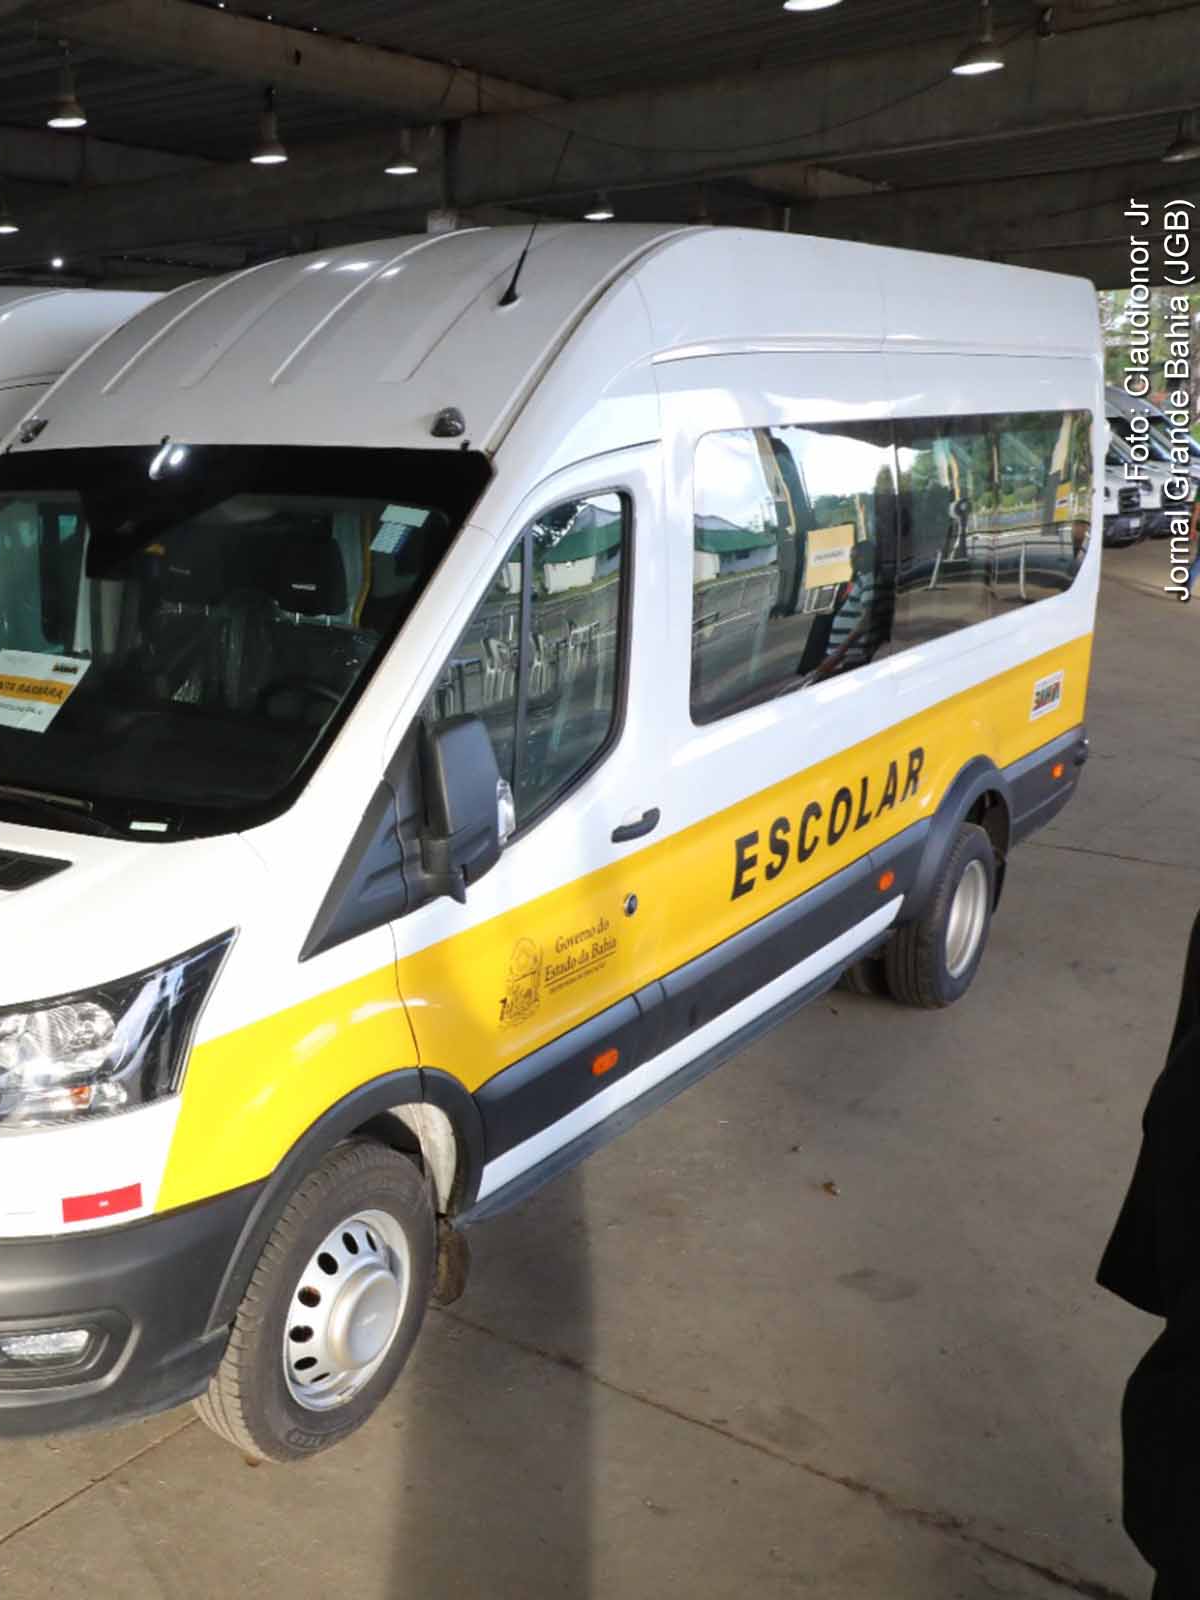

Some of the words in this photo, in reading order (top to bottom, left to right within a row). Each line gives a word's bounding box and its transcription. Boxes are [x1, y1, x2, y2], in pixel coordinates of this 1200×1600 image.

[731, 747, 925, 901] ESCOLAR
[555, 926, 596, 954] Governo
[597, 917, 610, 934] do
[544, 955, 577, 982] Estado
[578, 948, 590, 965] da
[591, 937, 617, 960] Bahia
